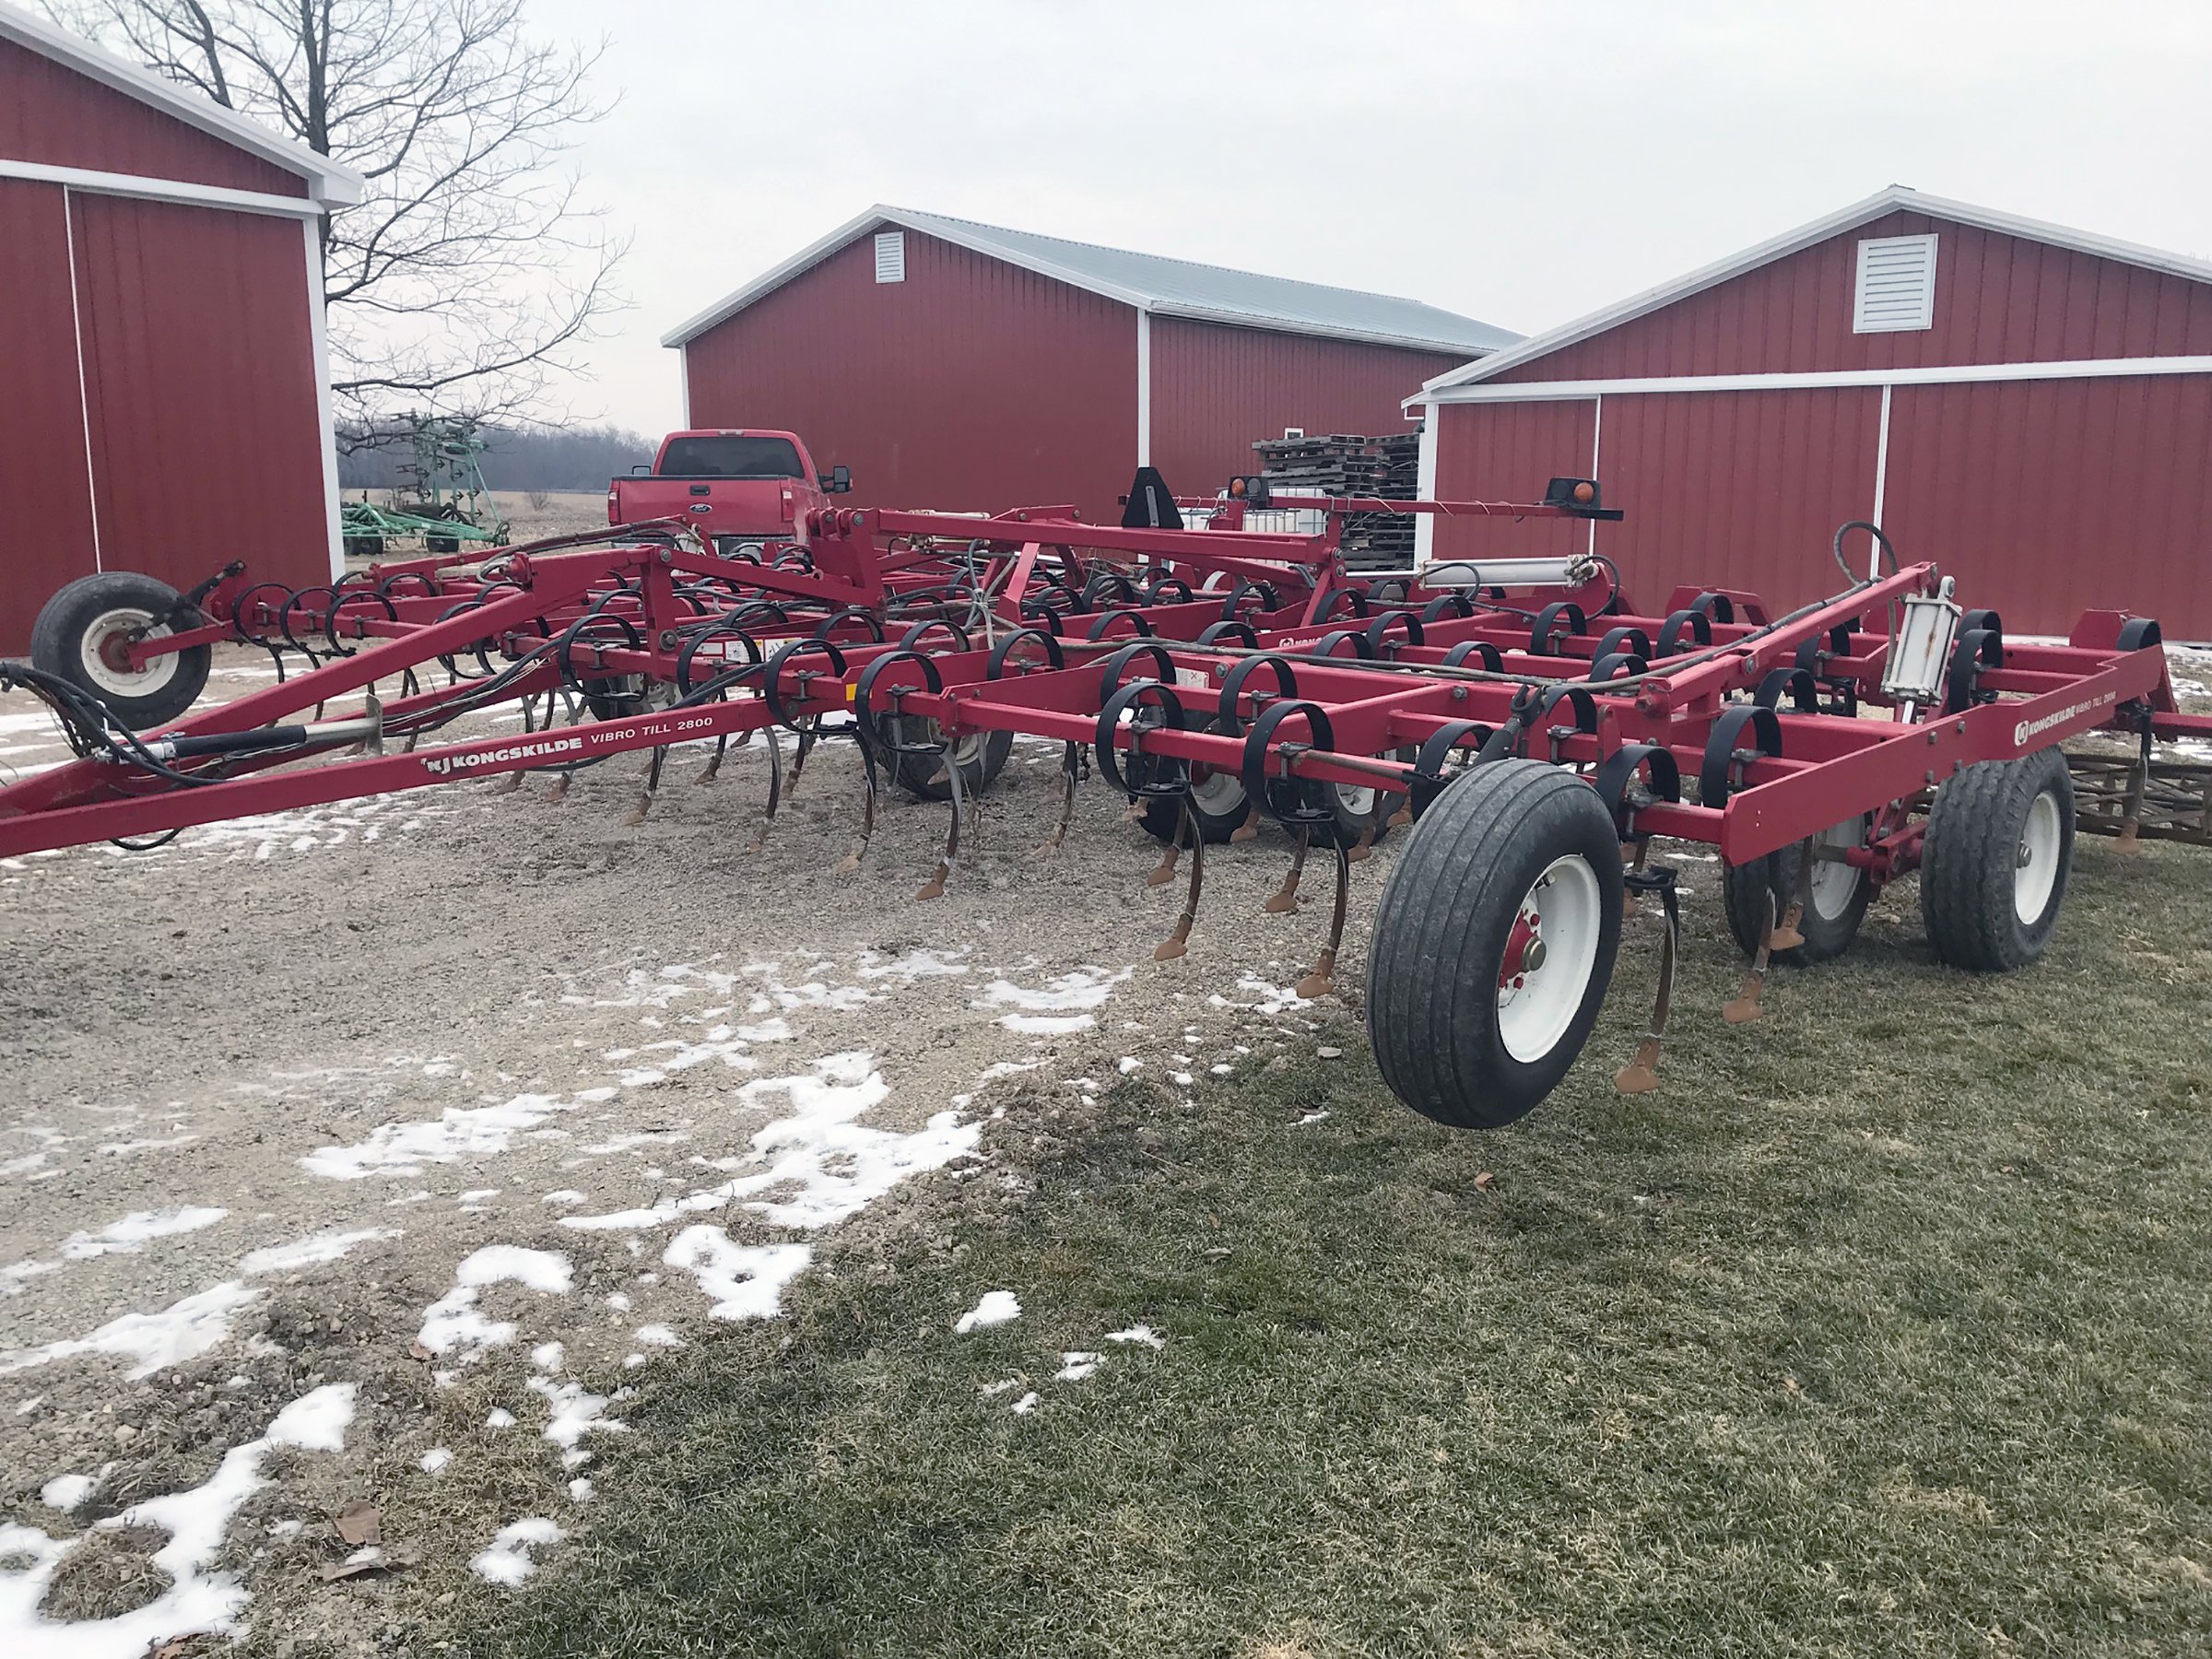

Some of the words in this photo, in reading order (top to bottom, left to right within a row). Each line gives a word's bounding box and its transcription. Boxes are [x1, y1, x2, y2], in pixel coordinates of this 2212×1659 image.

[2029, 705, 2076, 735] KONGSKILDE
[453, 737, 582, 768] KONGSKILDE
[591, 728, 636, 744] VIBRO
[641, 724, 671, 737] TILL
[677, 717, 713, 731] 2800
